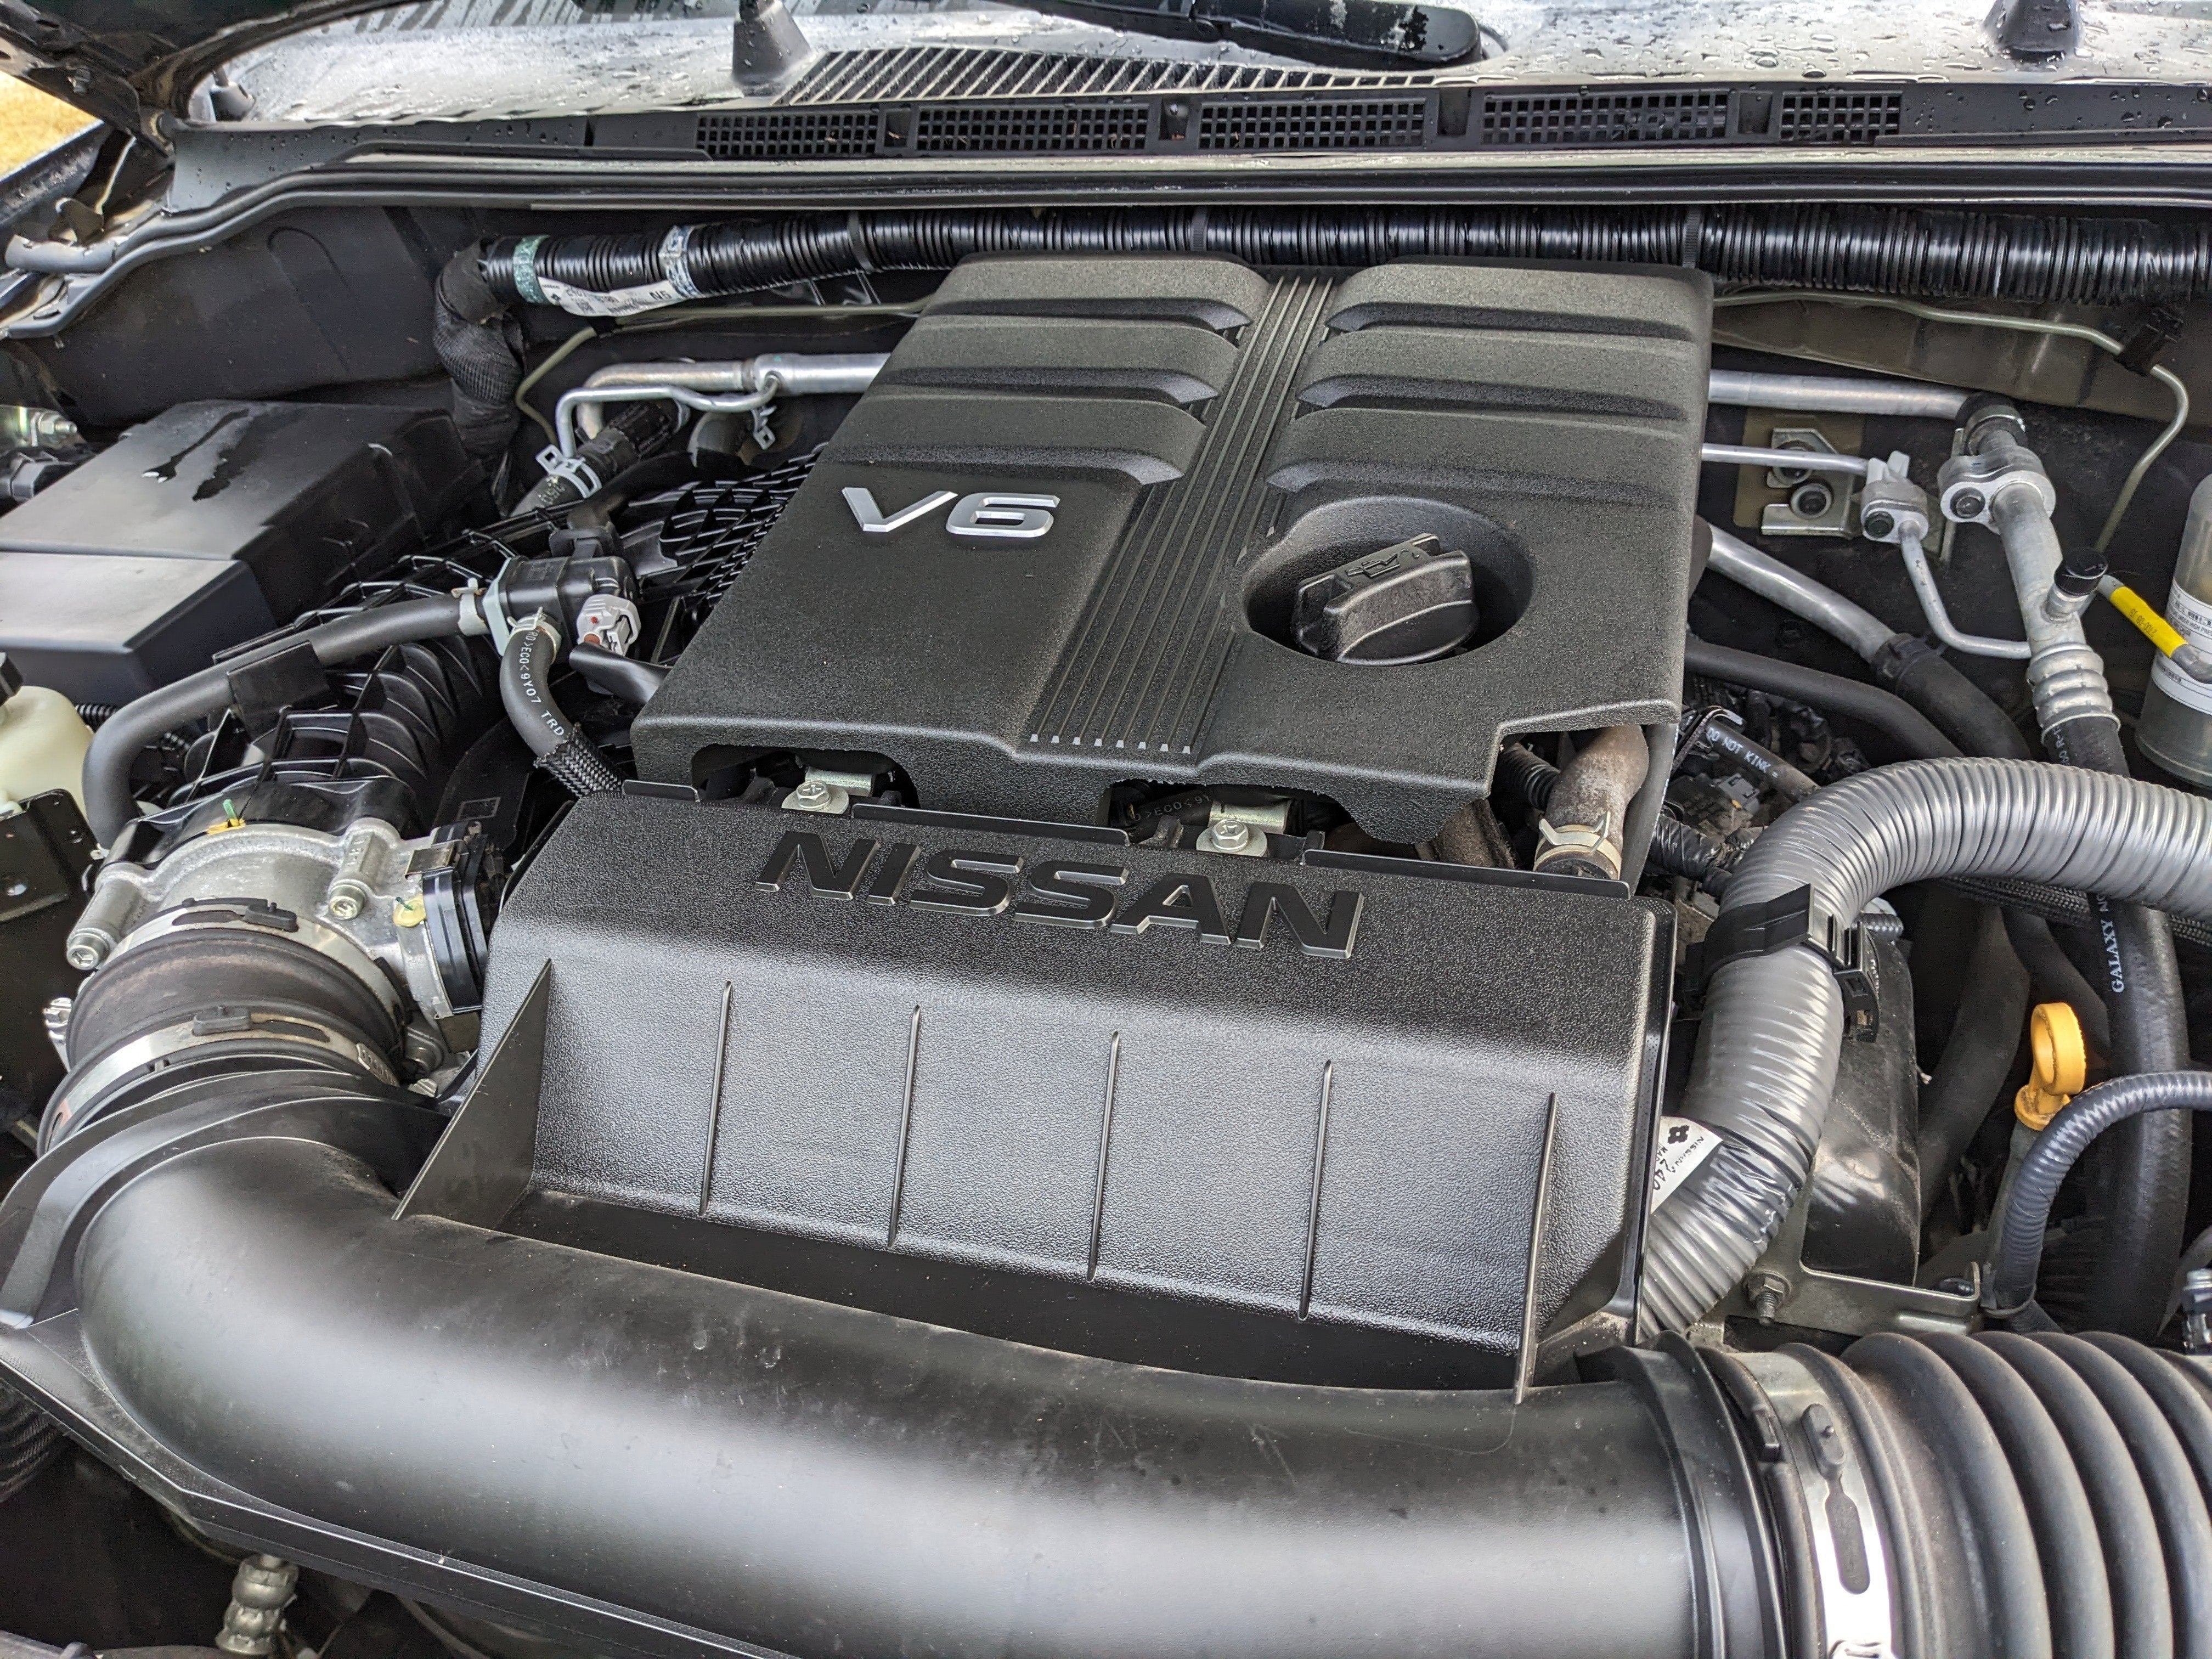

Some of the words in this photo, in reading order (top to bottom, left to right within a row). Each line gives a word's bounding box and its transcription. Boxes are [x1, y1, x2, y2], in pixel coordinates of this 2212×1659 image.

[842, 487, 1060, 538] V6
[541, 710, 565, 736] TRD
[1707, 726, 1720, 742] DO
[1722, 736, 1744, 754] NOT
[1744, 750, 1771, 774] KINK
[754, 831, 1364, 960] NISSAN
[2100, 919, 2125, 994] GALAXY
